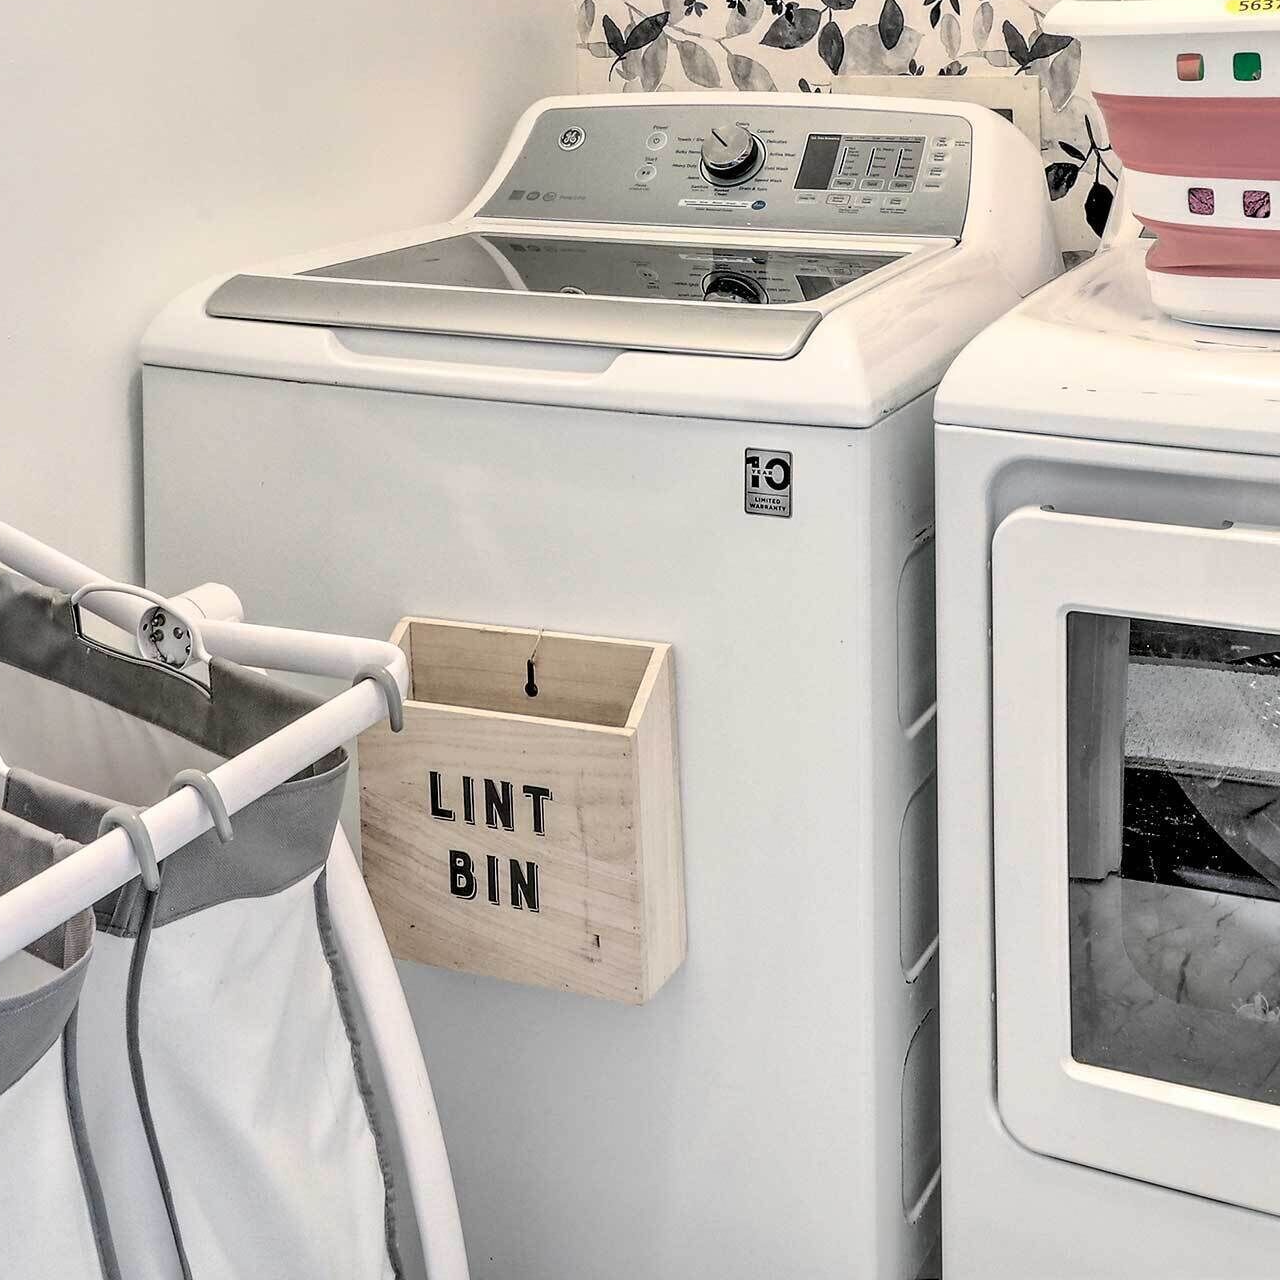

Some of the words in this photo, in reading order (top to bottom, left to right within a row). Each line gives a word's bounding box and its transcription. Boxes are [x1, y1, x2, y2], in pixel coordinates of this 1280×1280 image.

[746, 456, 791, 491] 10
[749, 503, 786, 511] WARRANTY
[755, 497, 781, 505] LIMITED
[429, 771, 553, 836] LINT
[449, 849, 540, 913] BIN
